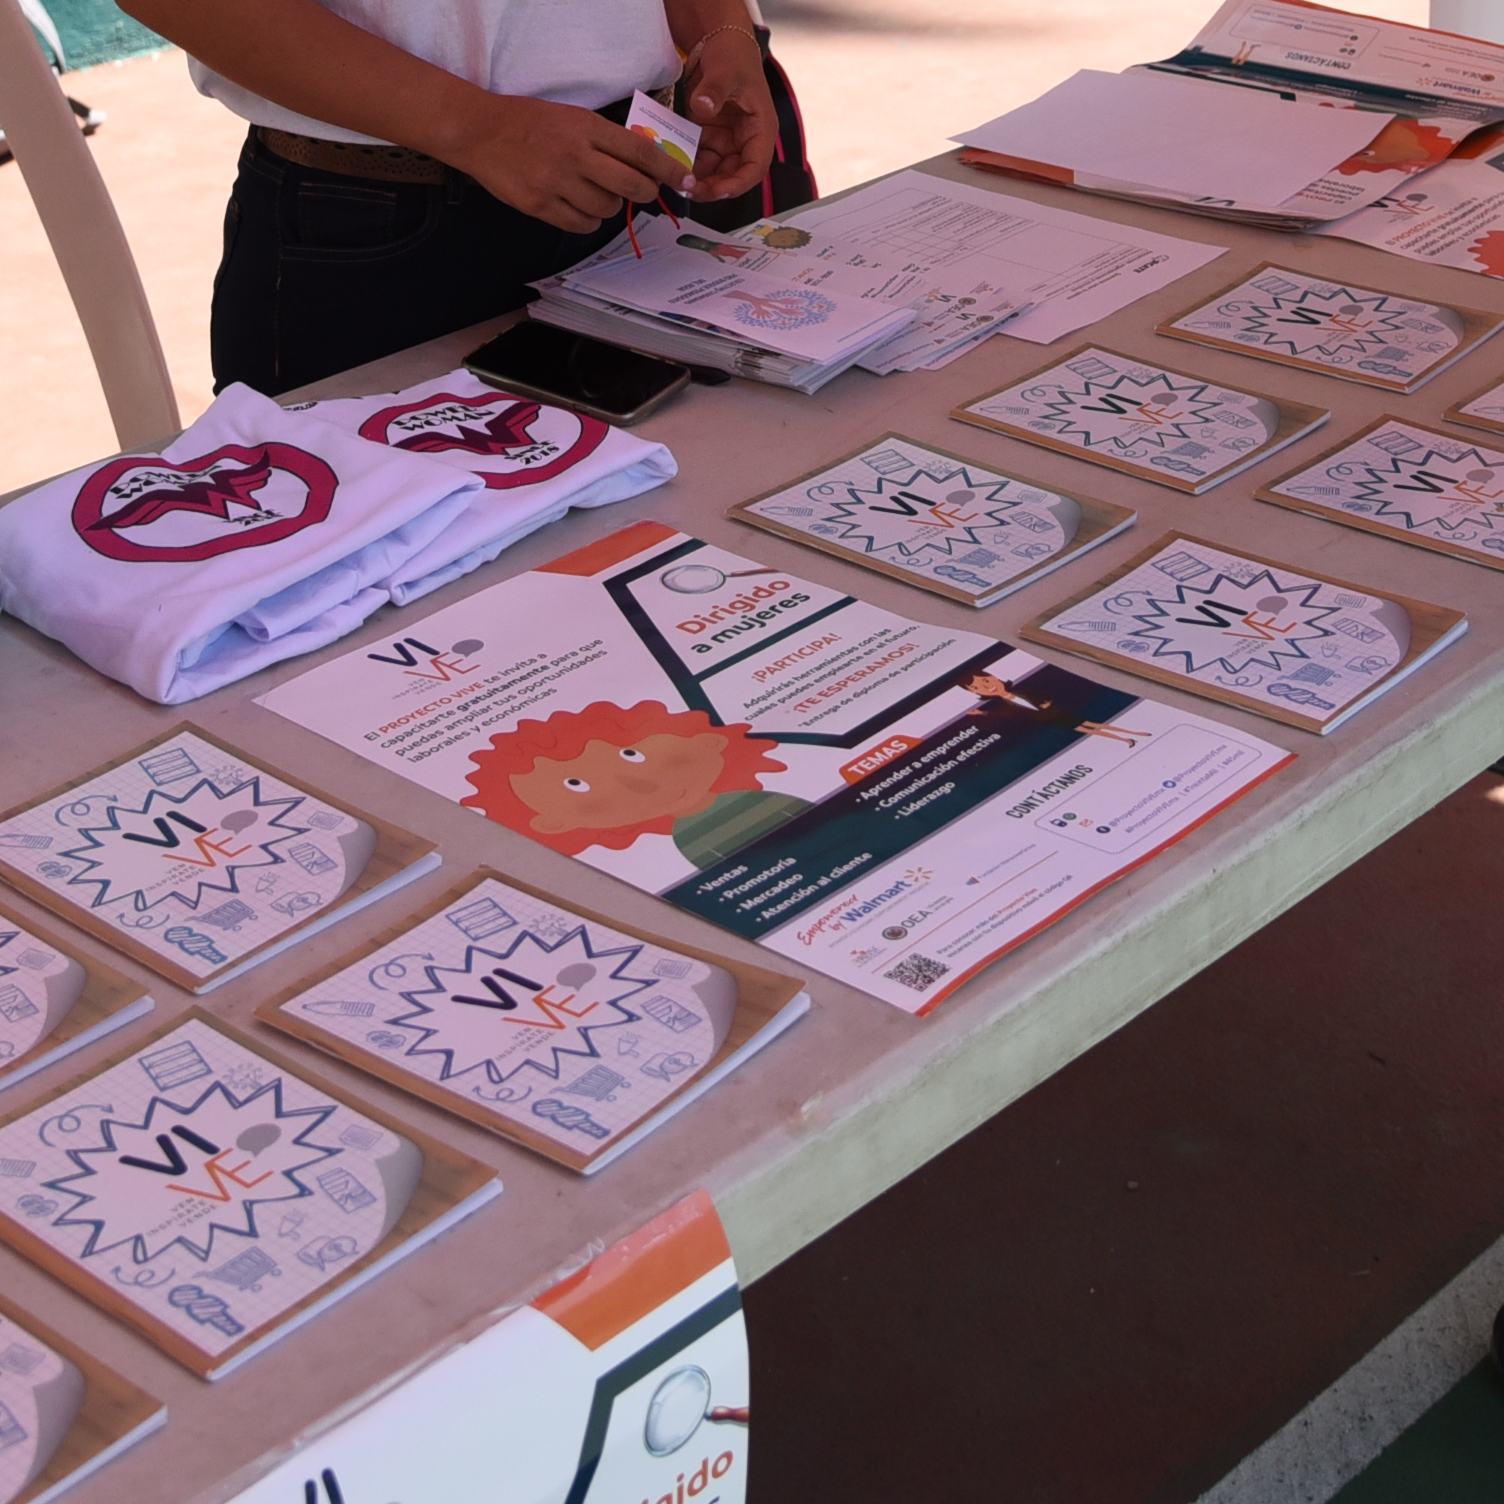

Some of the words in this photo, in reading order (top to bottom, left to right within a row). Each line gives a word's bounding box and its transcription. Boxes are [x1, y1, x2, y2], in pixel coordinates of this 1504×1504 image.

[1276, 306, 1333, 325] VI
[1314, 313, 1373, 333] VE
[1080, 393, 1143, 415] VI
[1117, 402, 1184, 425] VE
[520, 446, 560, 465] 2018
[868, 491, 937, 517] VI
[1393, 470, 1459, 494] VI
[1436, 480, 1504, 504] VE
[907, 501, 979, 529] VE
[675, 580, 791, 634] Dirigido
[691, 643, 713, 653] a
[710, 593, 811, 644] mujeres
[1175, 599, 1249, 628] VI
[1221, 610, 1298, 641] VE
[367, 637, 440, 667] VI
[403, 651, 481, 682] VE
[742, 679, 796, 710] Adquirirás
[794, 643, 860, 683] herramientas
[857, 635, 878, 648] con
[876, 627, 892, 639] las
[751, 632, 843, 684] ¡PARTICIPA!
[363, 731, 381, 741] El
[378, 697, 452, 734] PROYECTO
[450, 681, 485, 699] VIVE
[483, 673, 501, 684] te
[499, 658, 537, 677] invita
[535, 652, 548, 663] a
[380, 709, 457, 749] capacitarte
[456, 663, 550, 713] gratuitamente
[549, 649, 579, 667] para
[578, 638, 604, 653] que
[744, 700, 778, 722] cuales
[777, 681, 815, 705] puedes
[813, 654, 865, 685] emplearte
[864, 646, 878, 658] en
[877, 639, 886, 650] el
[793, 697, 821, 714] ¡TE
[817, 642, 920, 699] ESPERAMOS!
[394, 728, 445, 758] puedas
[444, 704, 494, 734] ampliar
[492, 690, 518, 707] tus
[516, 649, 608, 696] oportunidades
[406, 728, 472, 764] laborales
[470, 725, 482, 734] y
[480, 687, 558, 727] económicas
[847, 739, 908, 776] TEMAS
[859, 765, 914, 801] Aprender
[912, 761, 922, 769] a
[920, 724, 980, 764] emprender
[878, 758, 957, 809] Comunicación
[955, 732, 1002, 762] efectiva
[897, 781, 956, 817] Liderazgo
[1005, 764, 1094, 820] CONTÁCTANOS
[121, 810, 208, 848] VI
[161, 827, 253, 868] VE
[699, 864, 748, 893] Ventas
[722, 856, 797, 900] Promotoría
[739, 873, 803, 912] Mercadeo
[760, 883, 819, 920] Atención
[817, 875, 831, 887] al
[829, 851, 873, 879] cliente
[797, 894, 859, 946] Empowered
[830, 921, 847, 933] by
[839, 879, 913, 924] Walmart
[901, 909, 934, 930] OEA
[450, 967, 544, 1011] VI
[500, 984, 600, 1030] VE
[118, 1124, 221, 1176] VI
[165, 1147, 275, 1203] VE
